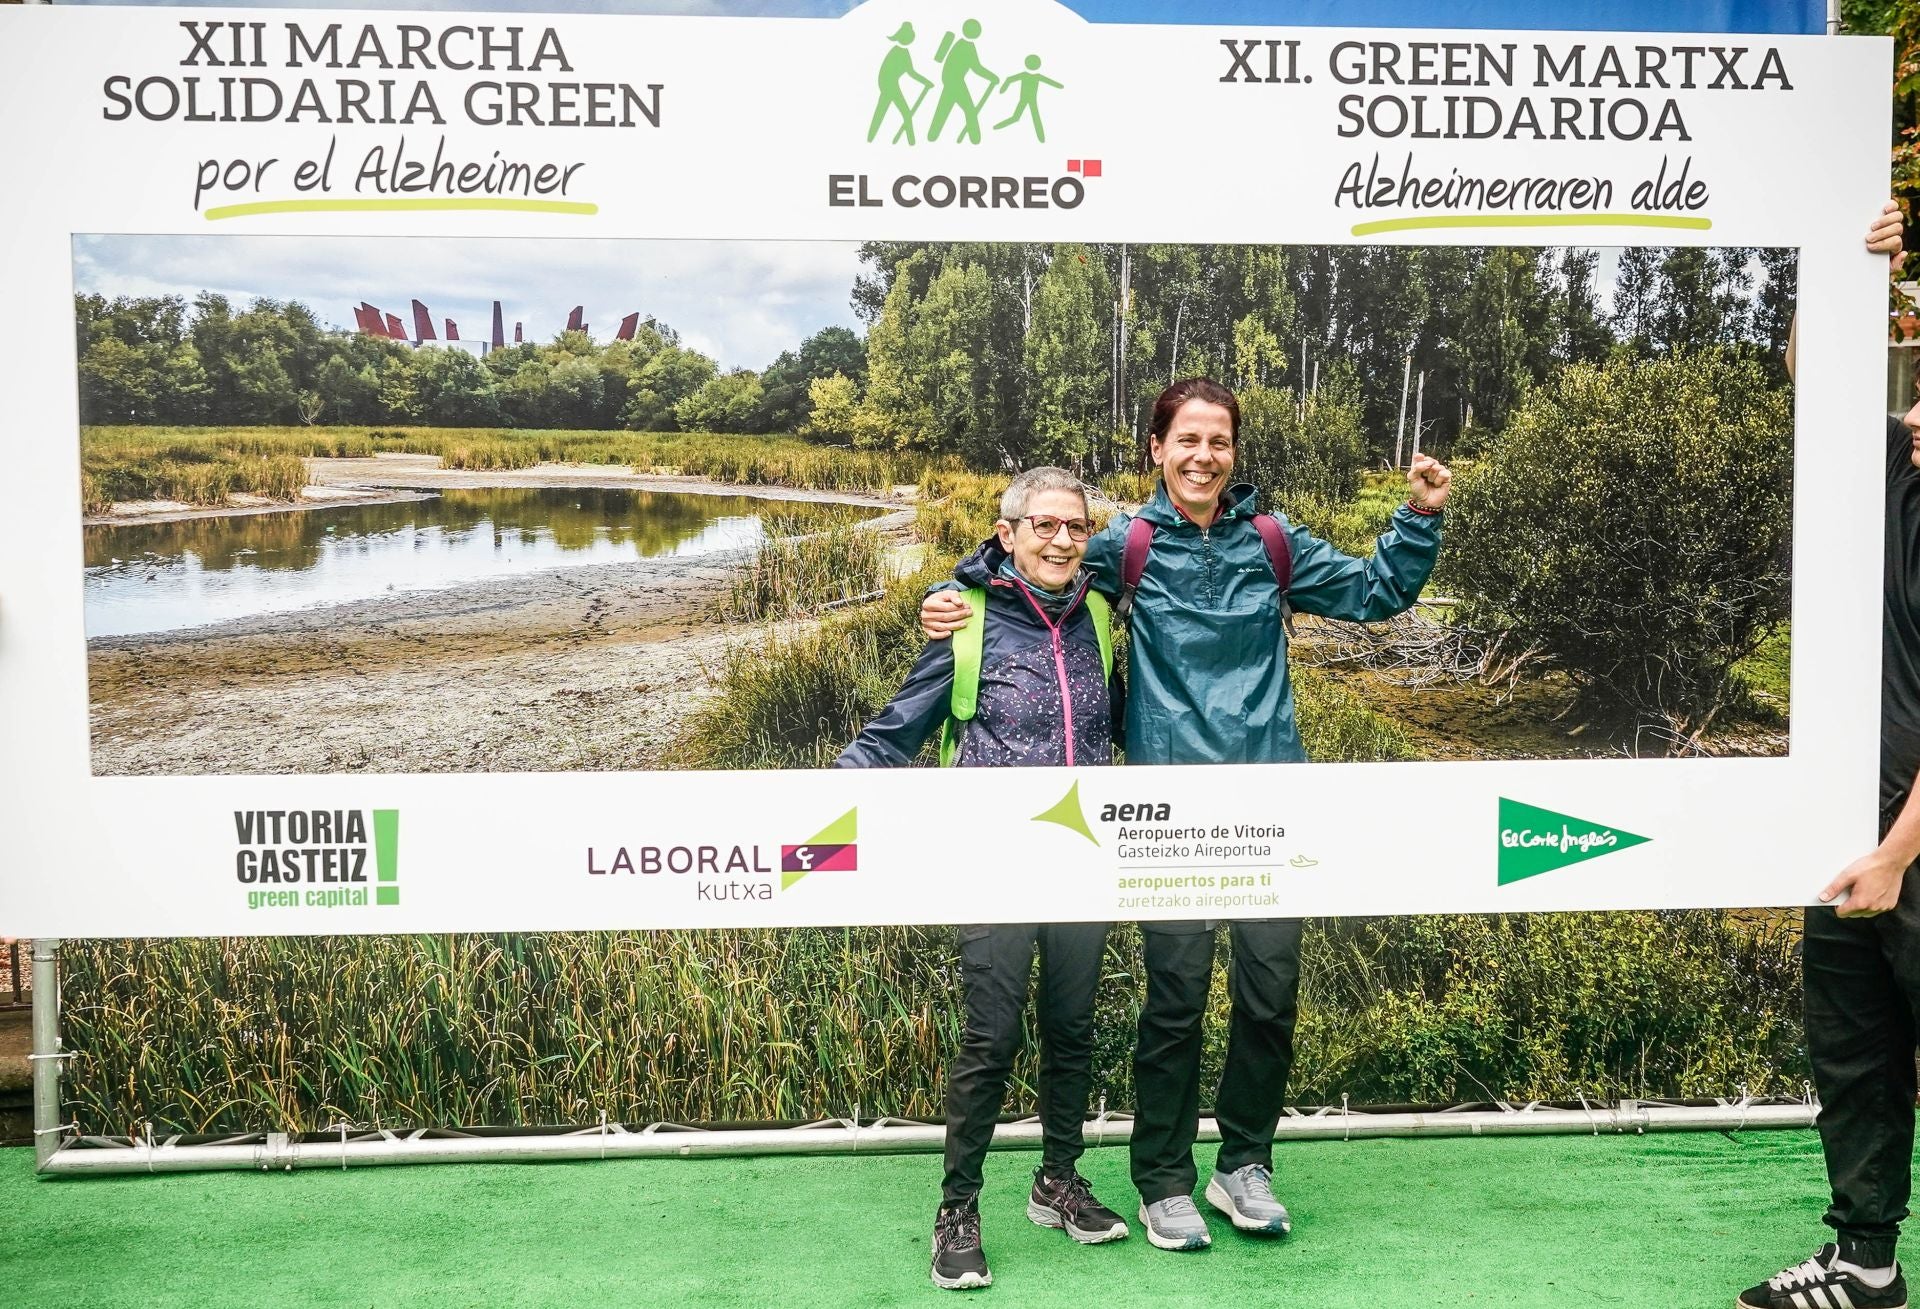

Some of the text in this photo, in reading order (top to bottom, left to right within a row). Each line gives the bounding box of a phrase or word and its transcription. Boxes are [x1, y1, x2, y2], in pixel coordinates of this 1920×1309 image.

[179, 21, 574, 72] XII MARCHA
[1219, 39, 1794, 91] XII. GREEN MARTXA
[103, 75, 664, 128] SOLIDARIA GREEN
[1337, 94, 1692, 141] SOLIDARIOA
[194, 134, 586, 210] por el Alzheimer
[1335, 151, 1709, 211] Alzheimerraren alde
[829, 174, 1085, 209] EL CORREO
[234, 809, 367, 845] VITORIA
[1100, 803, 1171, 822] aena
[1118, 825, 1284, 843] Aeropuerto de Vitoria
[1501, 829, 1519, 848] El
[1519, 829, 1559, 847] Corte
[236, 848, 367, 883] GASTEIZ
[588, 845, 771, 875] LABORAL
[1118, 844, 1270, 859] Gasteizko Aireportua
[248, 886, 368, 910] green capital
[698, 881, 772, 900] kutxa
[1118, 874, 1270, 891] aeropuertos para ti
[1118, 892, 1279, 908] zuretzako aireportuak
